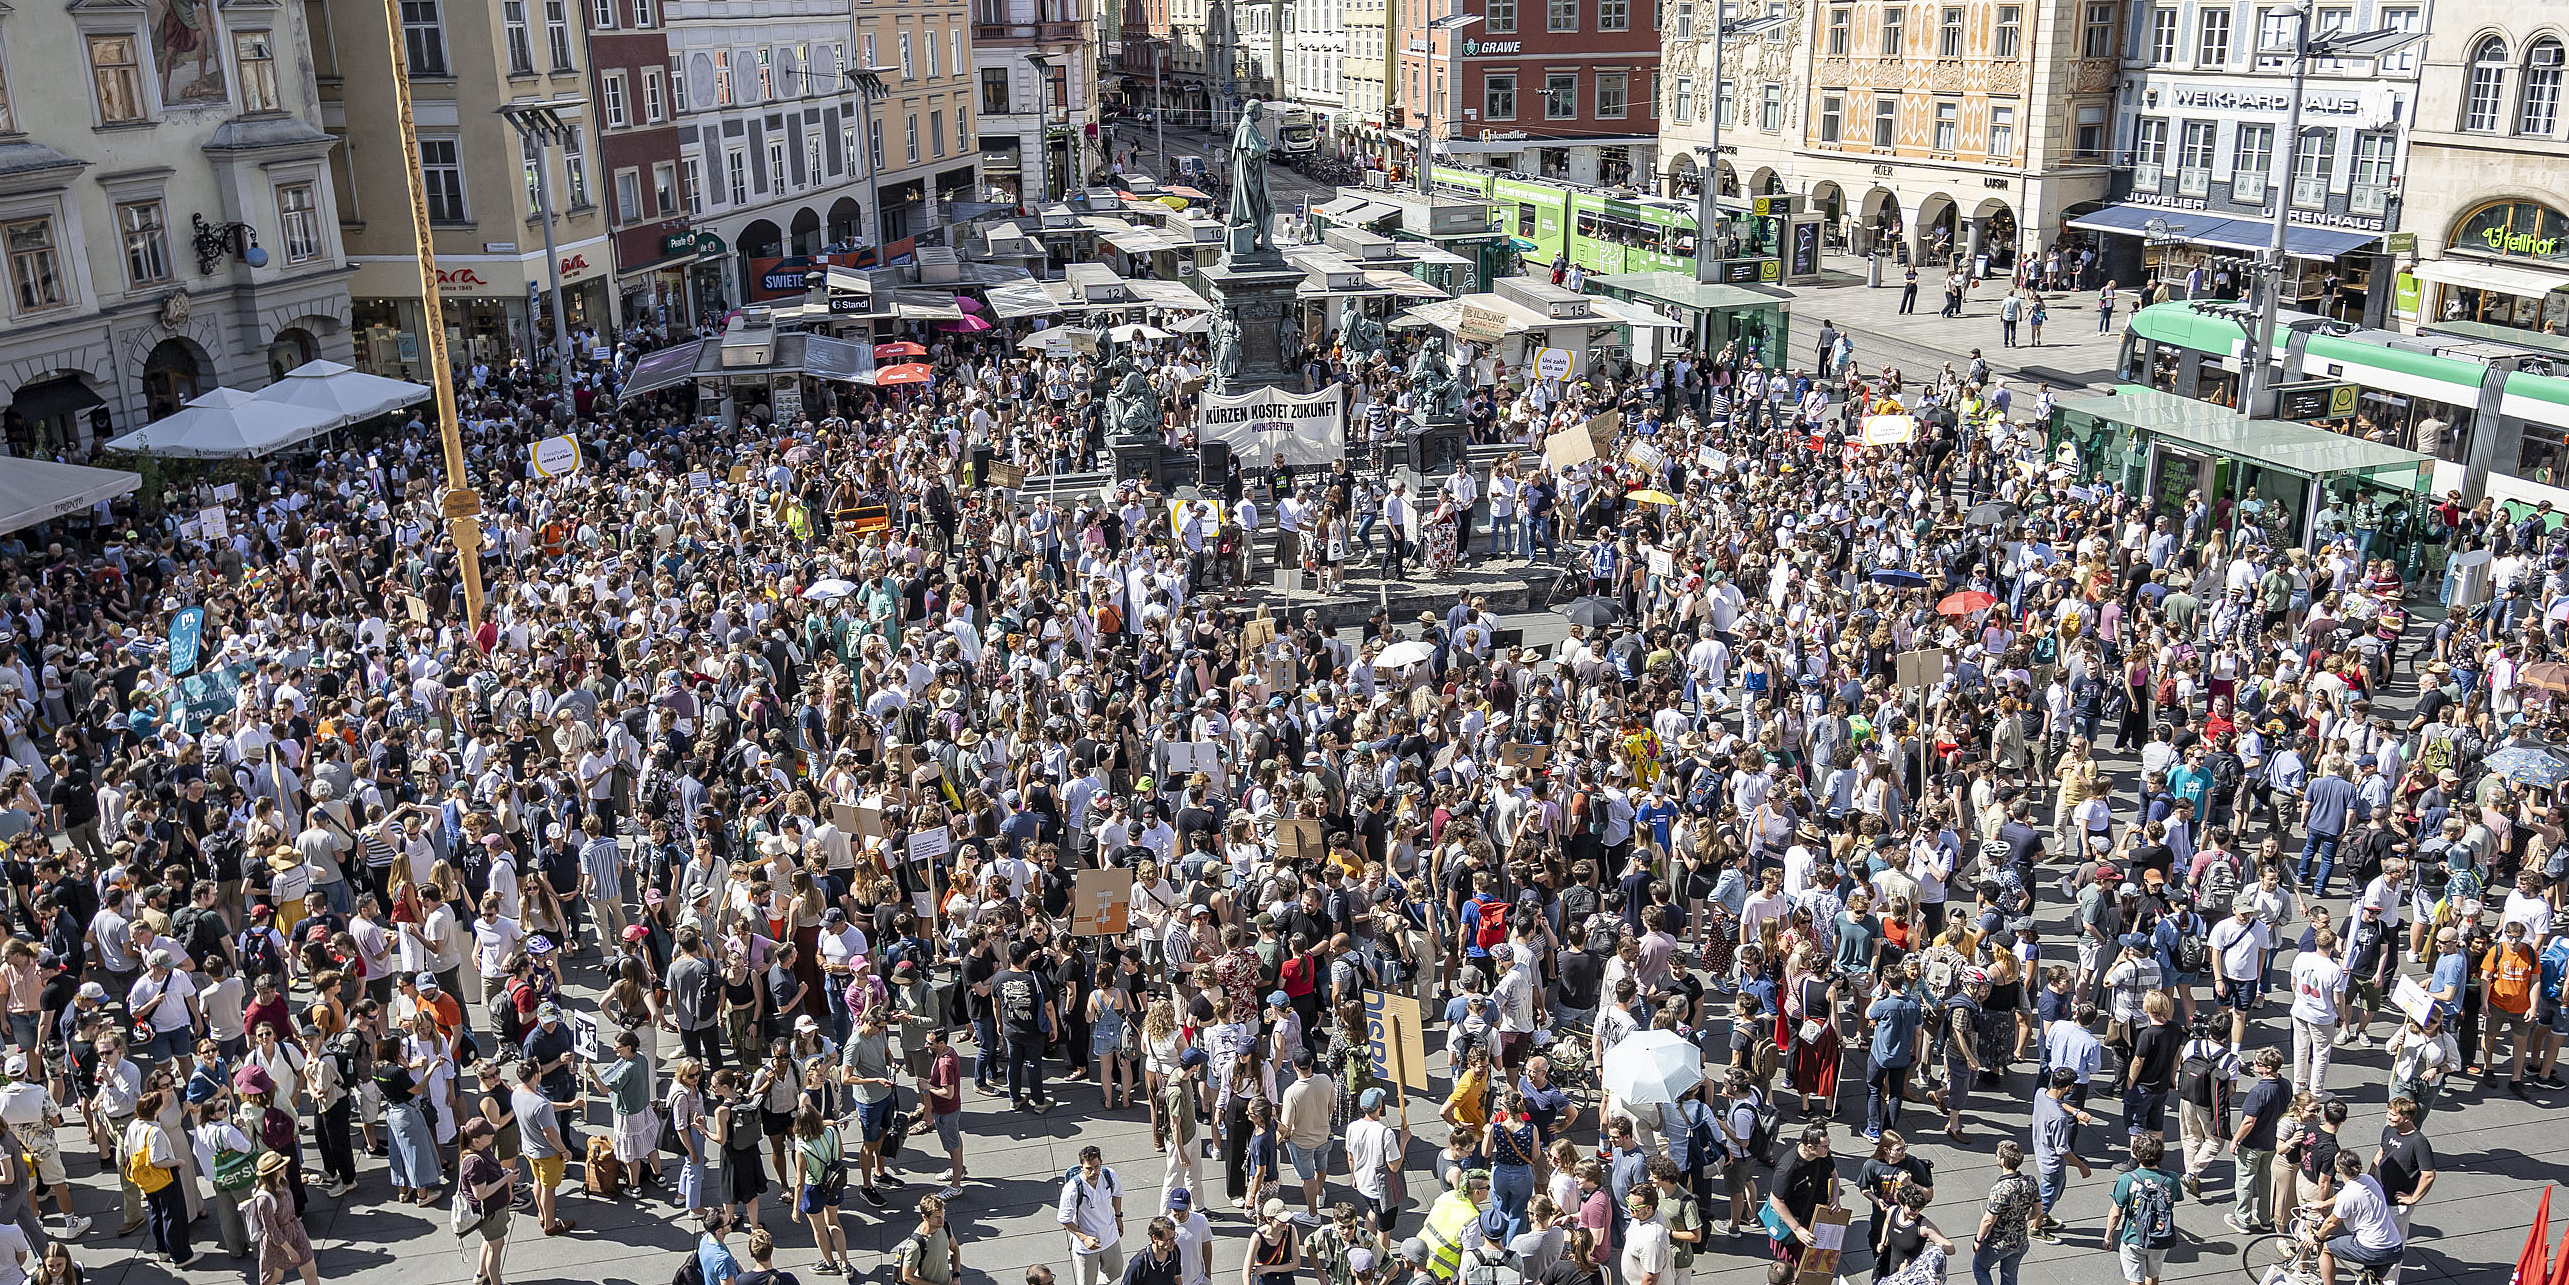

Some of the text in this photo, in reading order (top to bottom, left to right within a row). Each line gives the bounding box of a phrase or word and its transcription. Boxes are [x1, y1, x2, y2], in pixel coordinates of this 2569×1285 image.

[1481, 41, 1521, 53] GRAWE
[2174, 90, 2358, 112] WEIKHARDAUS
[1479, 129, 1527, 140] Hnkemöller
[395, 62, 436, 289] TRACHTENVERBAND
[1984, 177, 2008, 191] LUSH
[1110, 200, 1115, 208] 2
[2125, 192, 2206, 209] JUWELIER
[1064, 217, 1070, 226] 3
[2262, 206, 2385, 231] URENHAUS
[1210, 229, 1222, 239] 10
[1014, 241, 1020, 251] 4
[2504, 233, 2555, 255] fellhof
[1386, 247, 1392, 256] 8
[1347, 277, 1359, 287] 14
[1107, 288, 1120, 299] 12
[842, 300, 868, 309] Standl
[1466, 308, 1506, 324] BILDUNG
[1570, 305, 1585, 316] 15
[755, 351, 764, 364] 7
[1552, 358, 1567, 366] zahlt
[1206, 401, 1337, 425] KÜRZEN KOSTET ZUKUNFT
[543, 447, 568, 458] Forschung
[541, 453, 573, 464] rettet Leben
[2408, 541, 2418, 569] TICKETS
